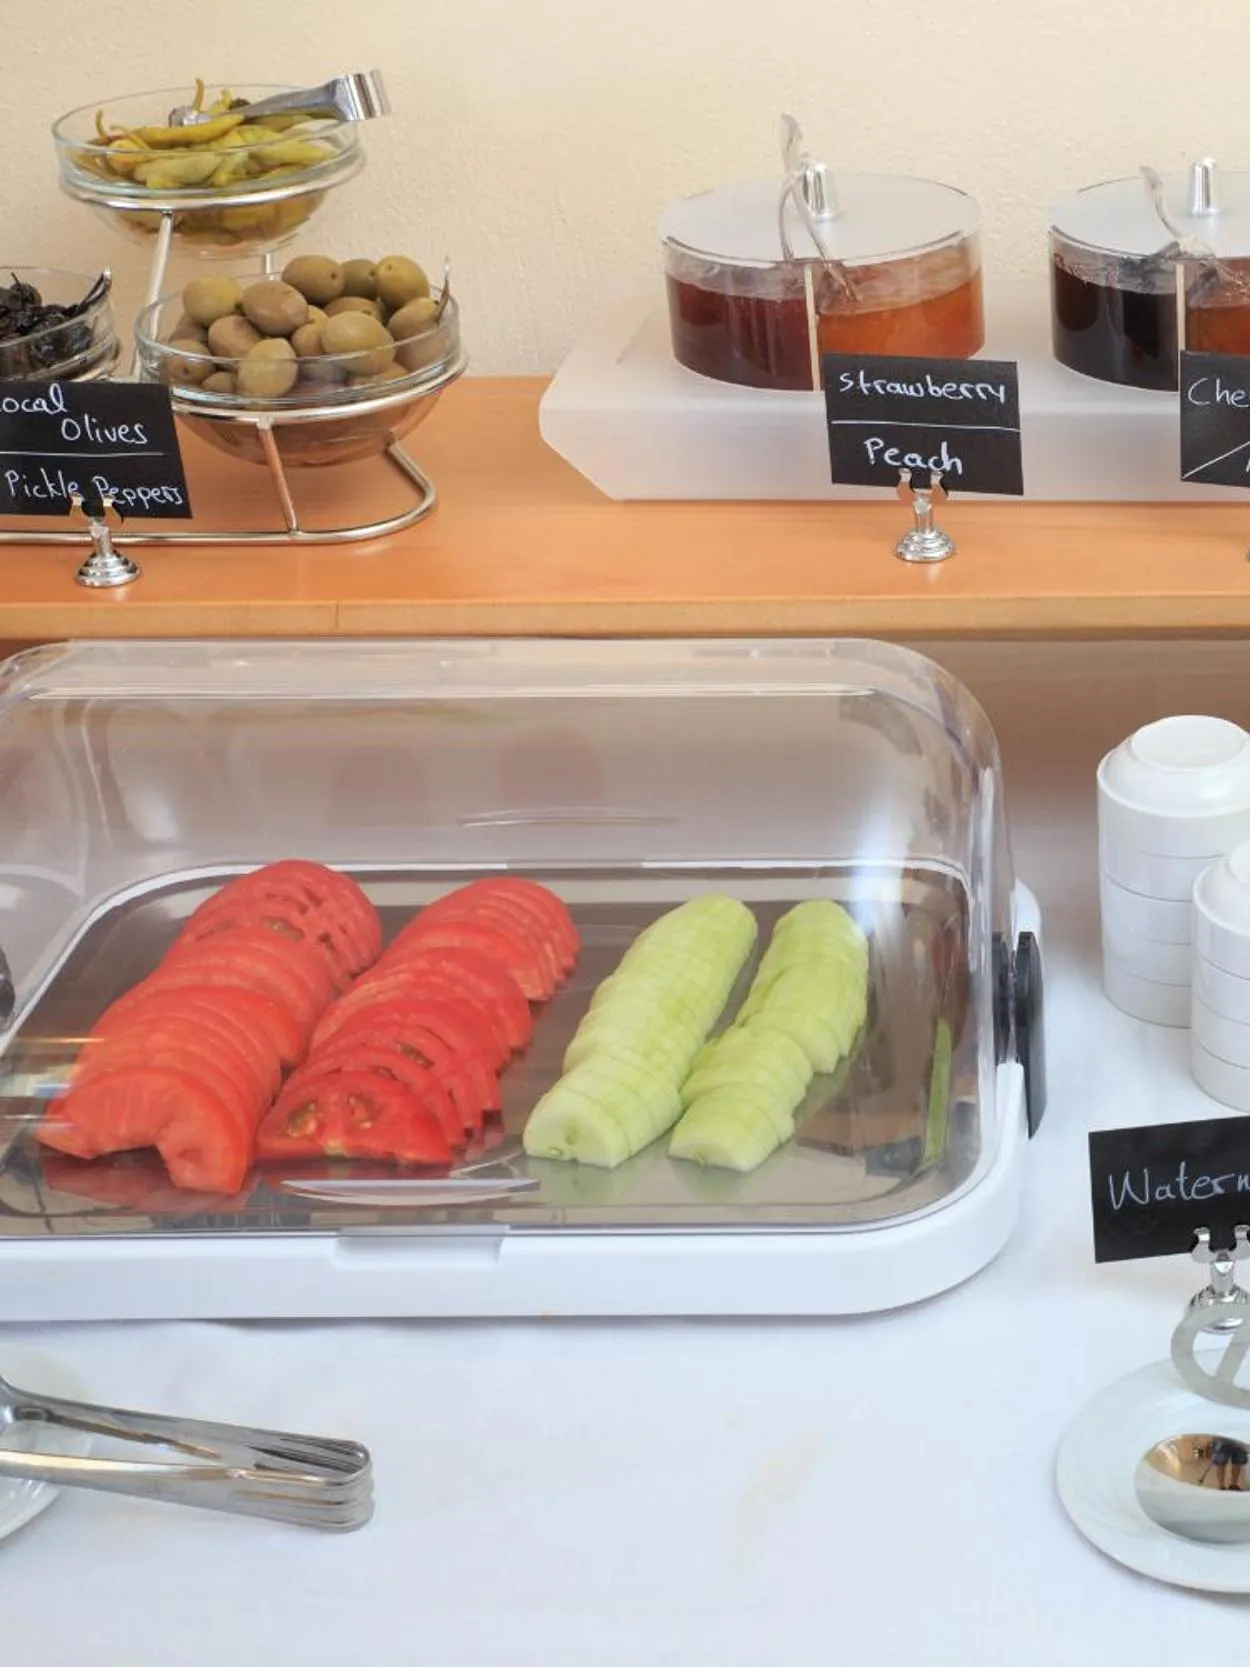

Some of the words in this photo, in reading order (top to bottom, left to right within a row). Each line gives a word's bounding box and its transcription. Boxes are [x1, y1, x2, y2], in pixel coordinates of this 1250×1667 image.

[0, 382, 68, 415] ocal
[61, 413, 149, 445] Olives
[863, 437, 964, 476] Peach
[4, 467, 81, 500] Pickle
